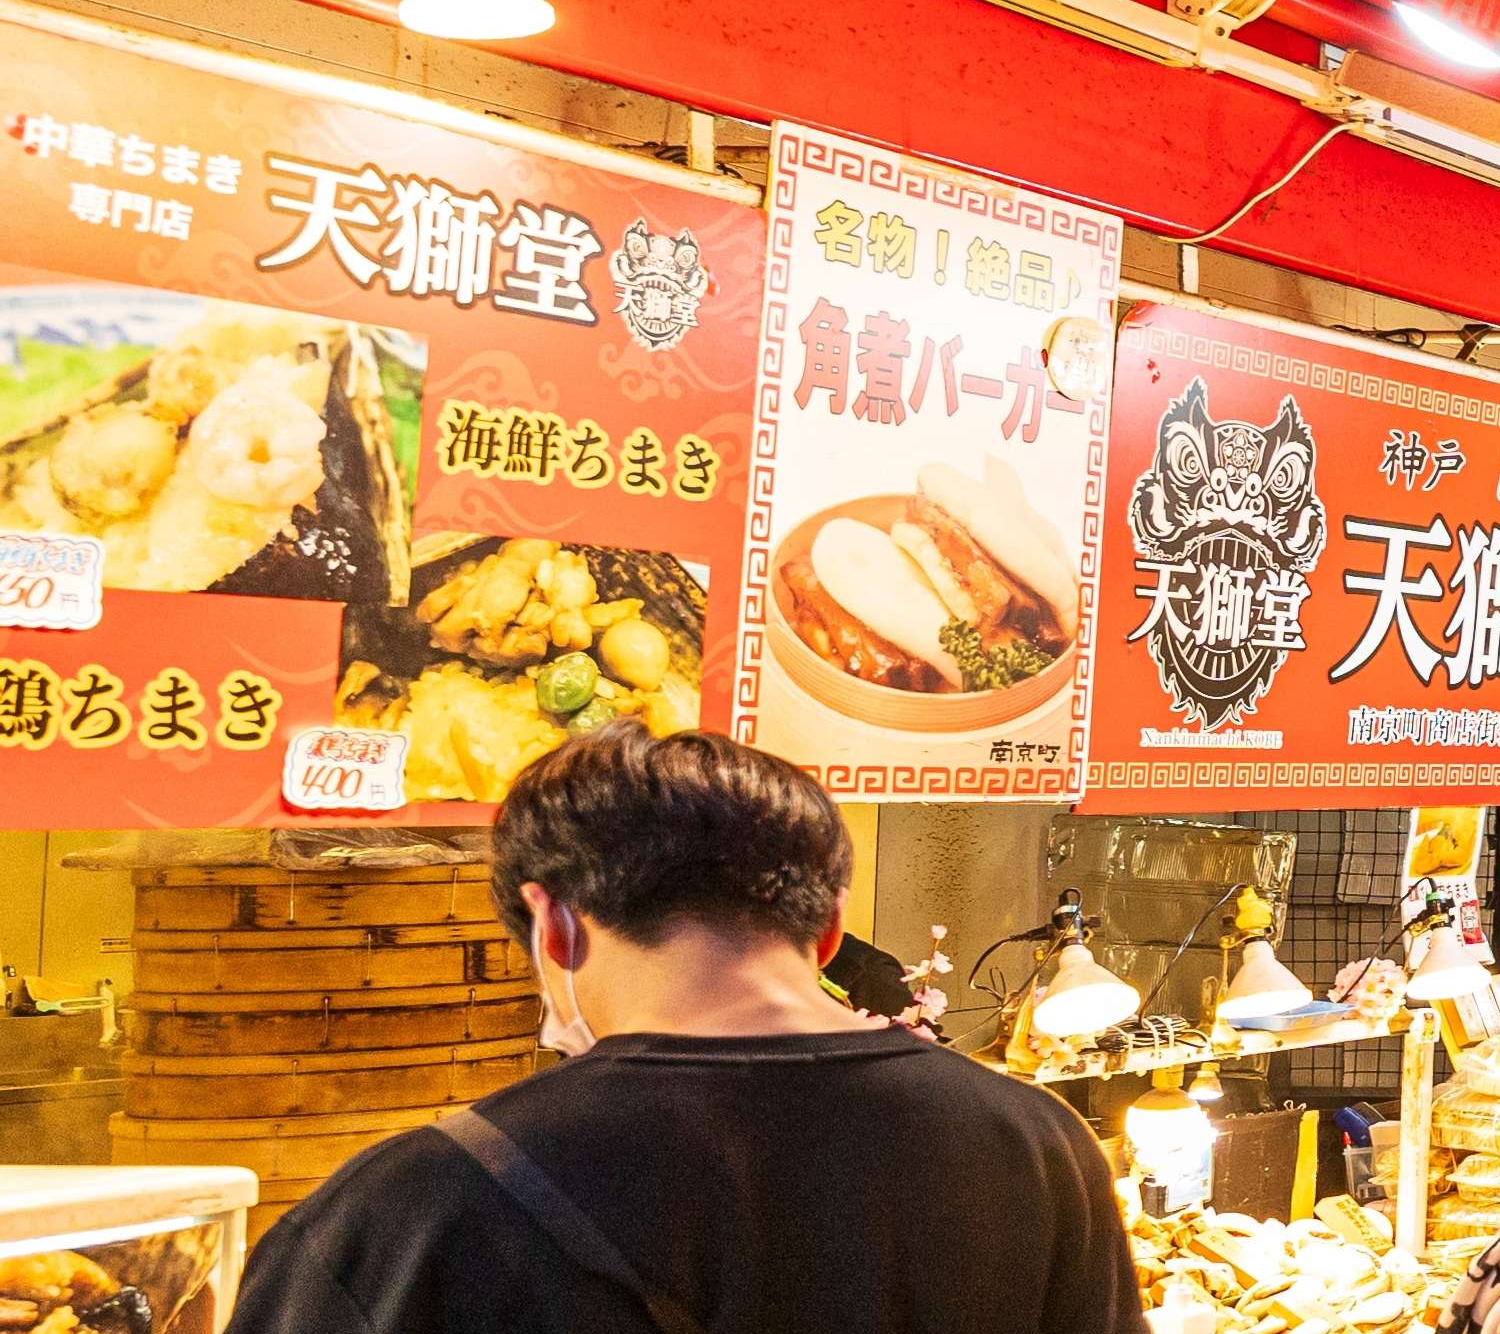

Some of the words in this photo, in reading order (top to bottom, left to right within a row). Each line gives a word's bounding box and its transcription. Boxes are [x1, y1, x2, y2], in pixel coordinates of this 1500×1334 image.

[22, 114, 244, 195] 中華ちまき
[68, 180, 194, 241] 専門店
[257, 151, 606, 327] 天獅堂
[795, 297, 1085, 444] 角煮バーガー
[442, 401, 719, 501] 海鮮ちまき
[1379, 430, 1466, 491] 神戸
[1126, 557, 1312, 652] 天獅堂
